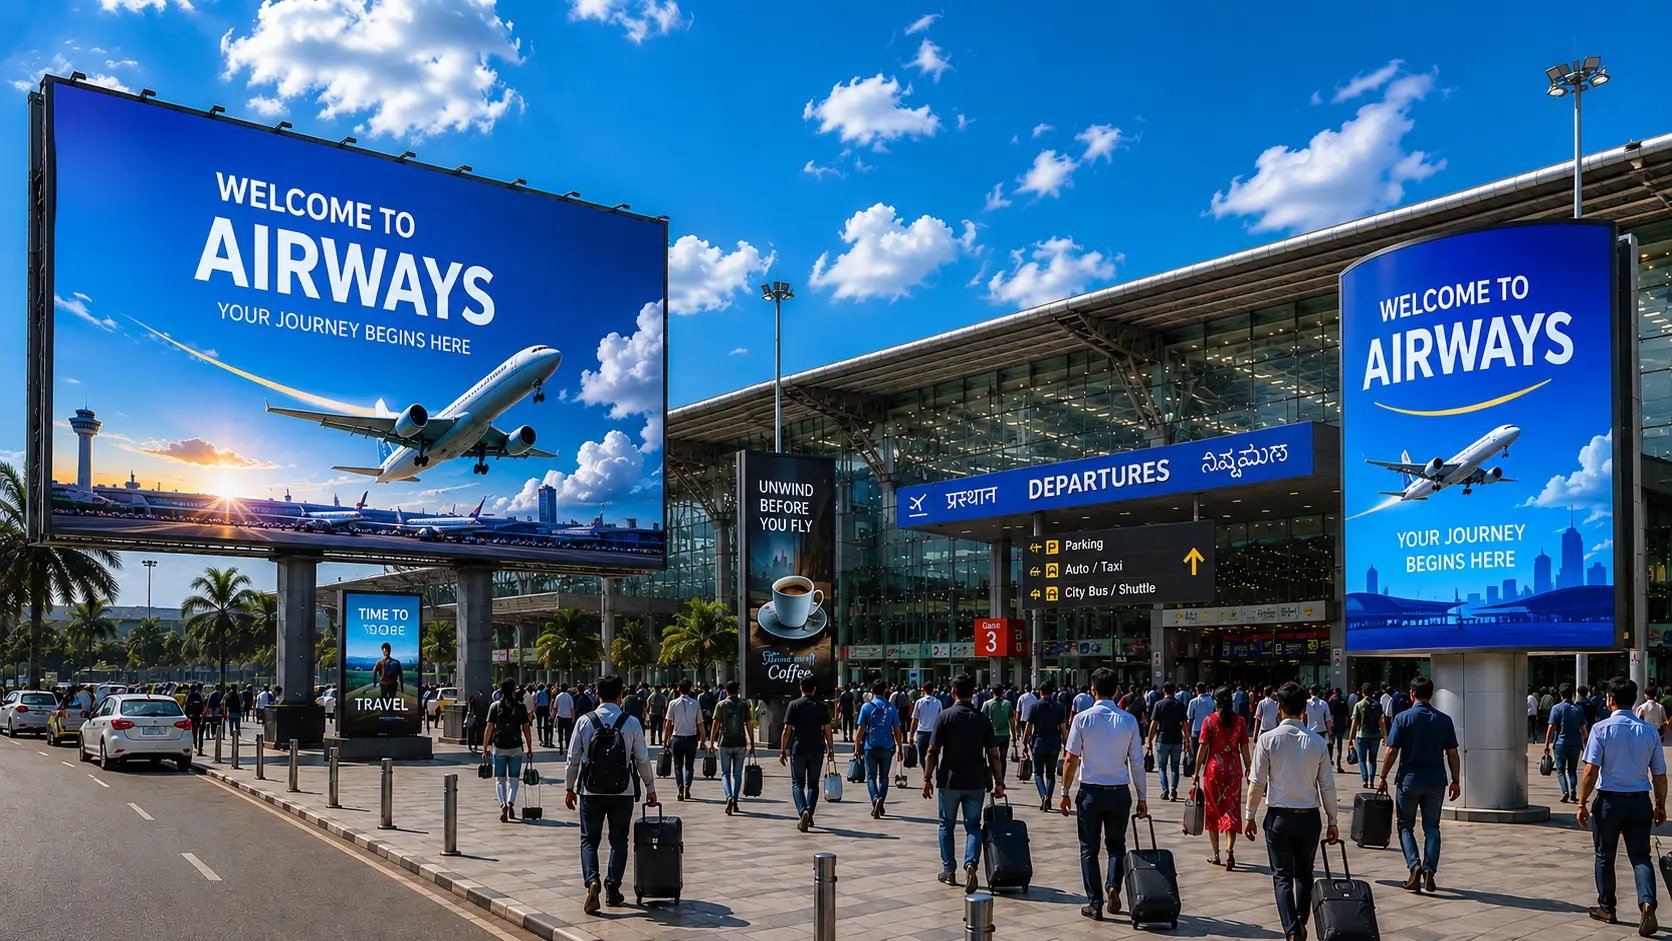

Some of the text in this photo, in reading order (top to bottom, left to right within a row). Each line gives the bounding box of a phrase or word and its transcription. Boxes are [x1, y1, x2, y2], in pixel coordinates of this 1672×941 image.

[215, 171, 416, 238] WELCOME TO
[194, 216, 496, 327] AIRWAYS
[1379, 275, 1530, 323] WELCOME TO
[217, 301, 471, 356] YOUR JOURNEY BEGINS HERE
[1362, 310, 1575, 392] AIRWAYS
[759, 479, 814, 497] UNWIND
[1029, 459, 1170, 500] DEPARTURES
[760, 498, 810, 515] BEFORE
[945, 486, 998, 510] प्रस्थान
[759, 516, 813, 534] YOU FLY
[1397, 524, 1526, 549] YOUR JOURNEY
[1064, 538, 1104, 552] Parking
[1064, 563, 1090, 576] Auto
[1101, 560, 1123, 573] Taxi
[1405, 550, 1516, 574] BEGINS HERE
[1064, 586, 1086, 600] City
[1088, 585, 1109, 597] Bus
[1118, 582, 1156, 596] Shuttle
[358, 607, 409, 621] TIME TO
[985, 630, 998, 653] 3
[767, 663, 813, 684] Coffee
[354, 697, 409, 711] TRAVEL
